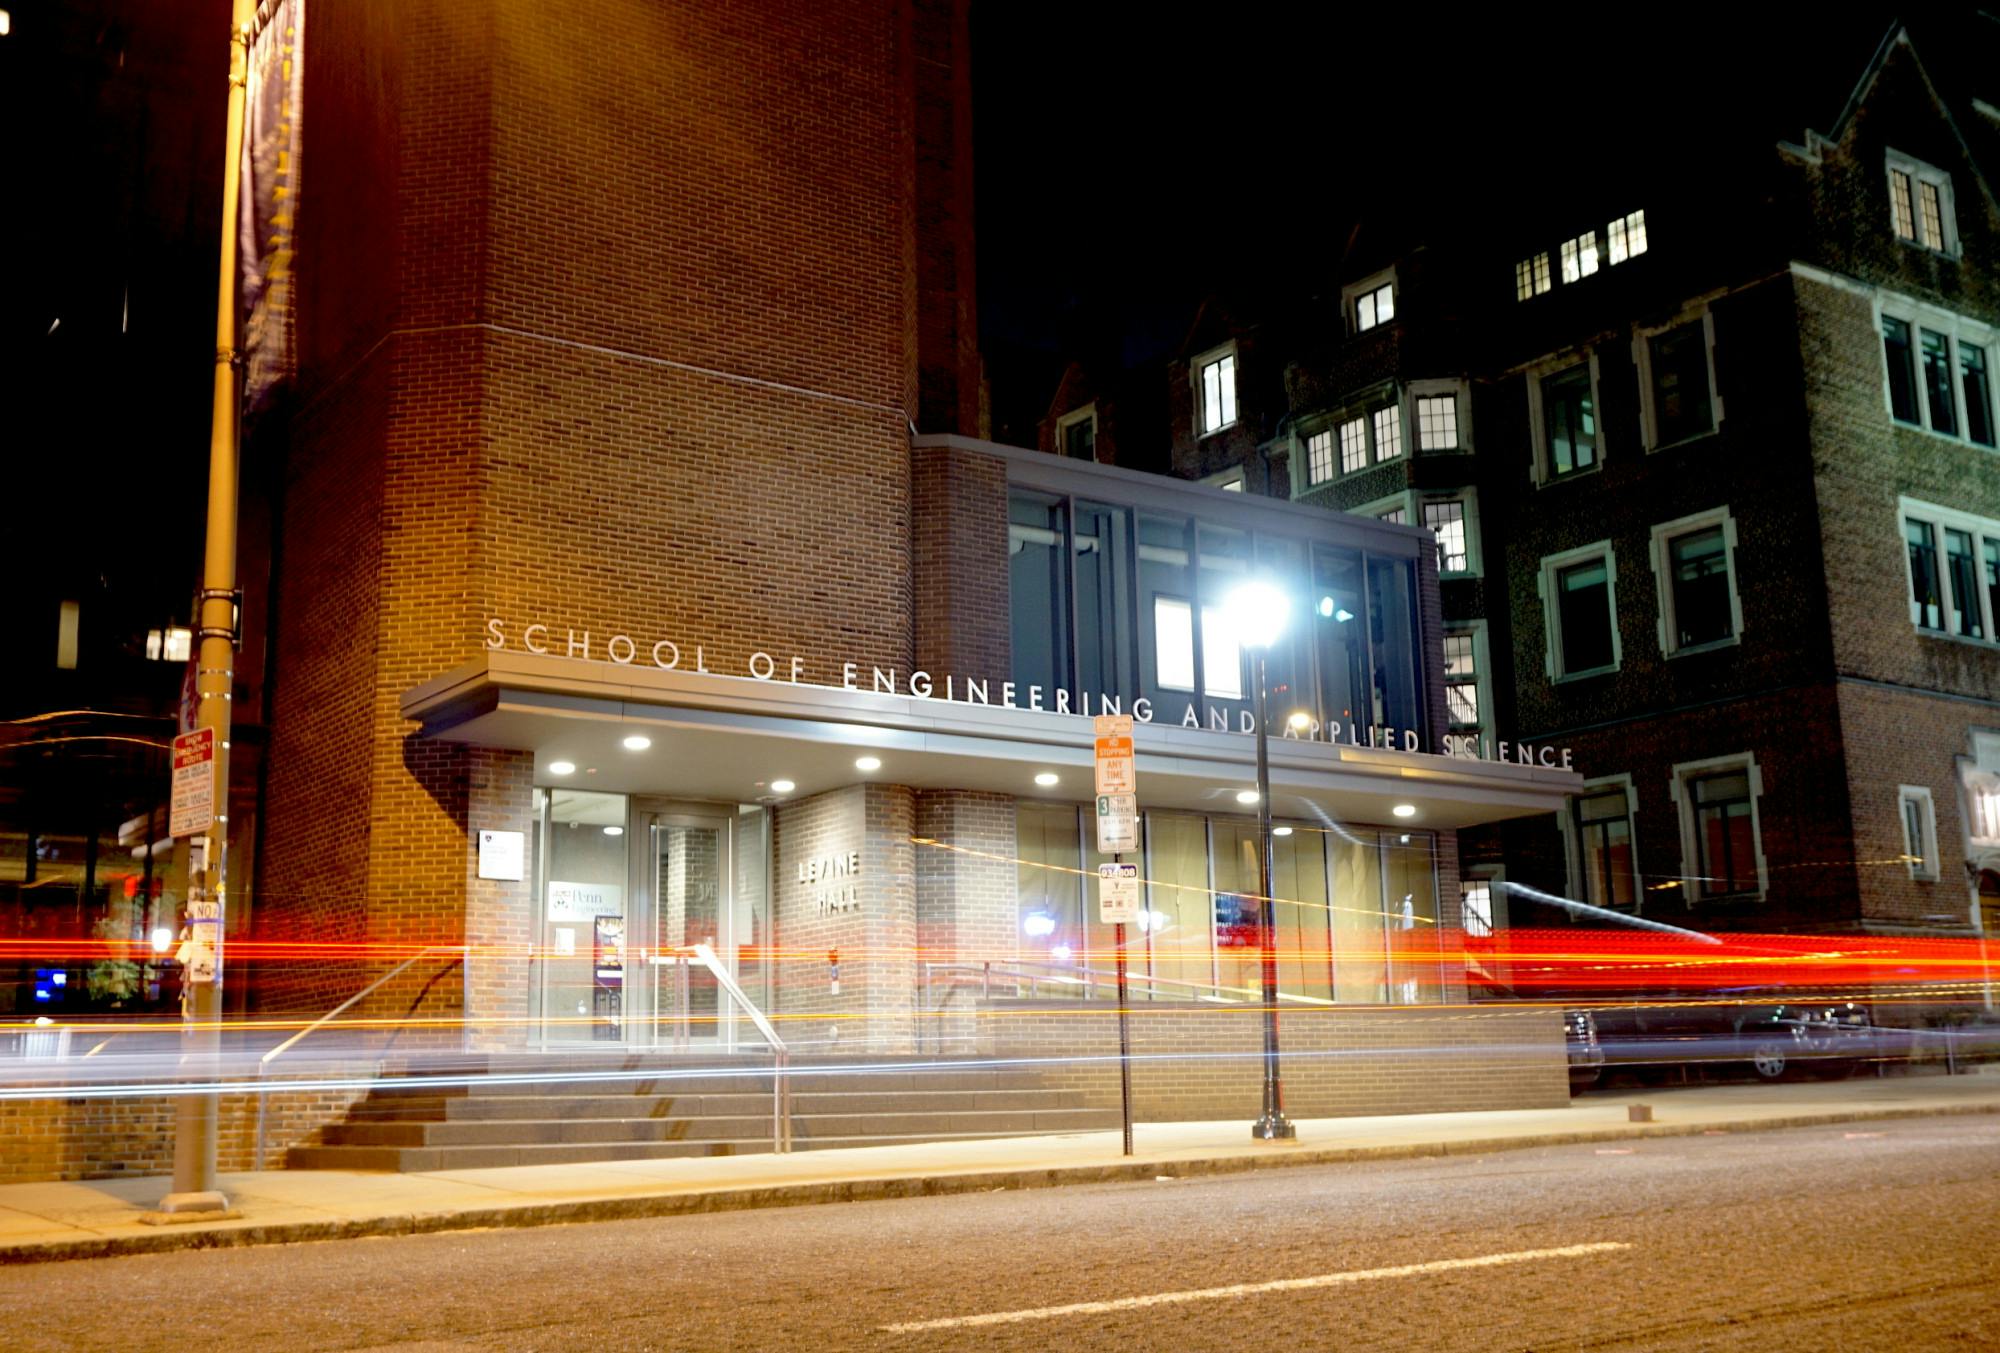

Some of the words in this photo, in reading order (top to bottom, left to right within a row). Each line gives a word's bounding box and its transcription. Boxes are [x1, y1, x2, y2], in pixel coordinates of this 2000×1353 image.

[487, 618, 709, 672] SCHOOL
[749, 652, 804, 683] OF
[843, 662, 1153, 723] ENGINEERING
[1182, 703, 1256, 734] AND
[1283, 719, 1419, 753] APPLIED
[1443, 733, 1573, 770] SCIENCE
[1106, 760, 1123, 769] ANY
[1106, 770, 1123, 779] TIME
[1100, 797, 1108, 814] 3
[799, 851, 860, 885] LEVINE
[573, 888, 602, 904] Penn
[818, 885, 860, 917] HALL
[197, 904, 212, 918] NO
